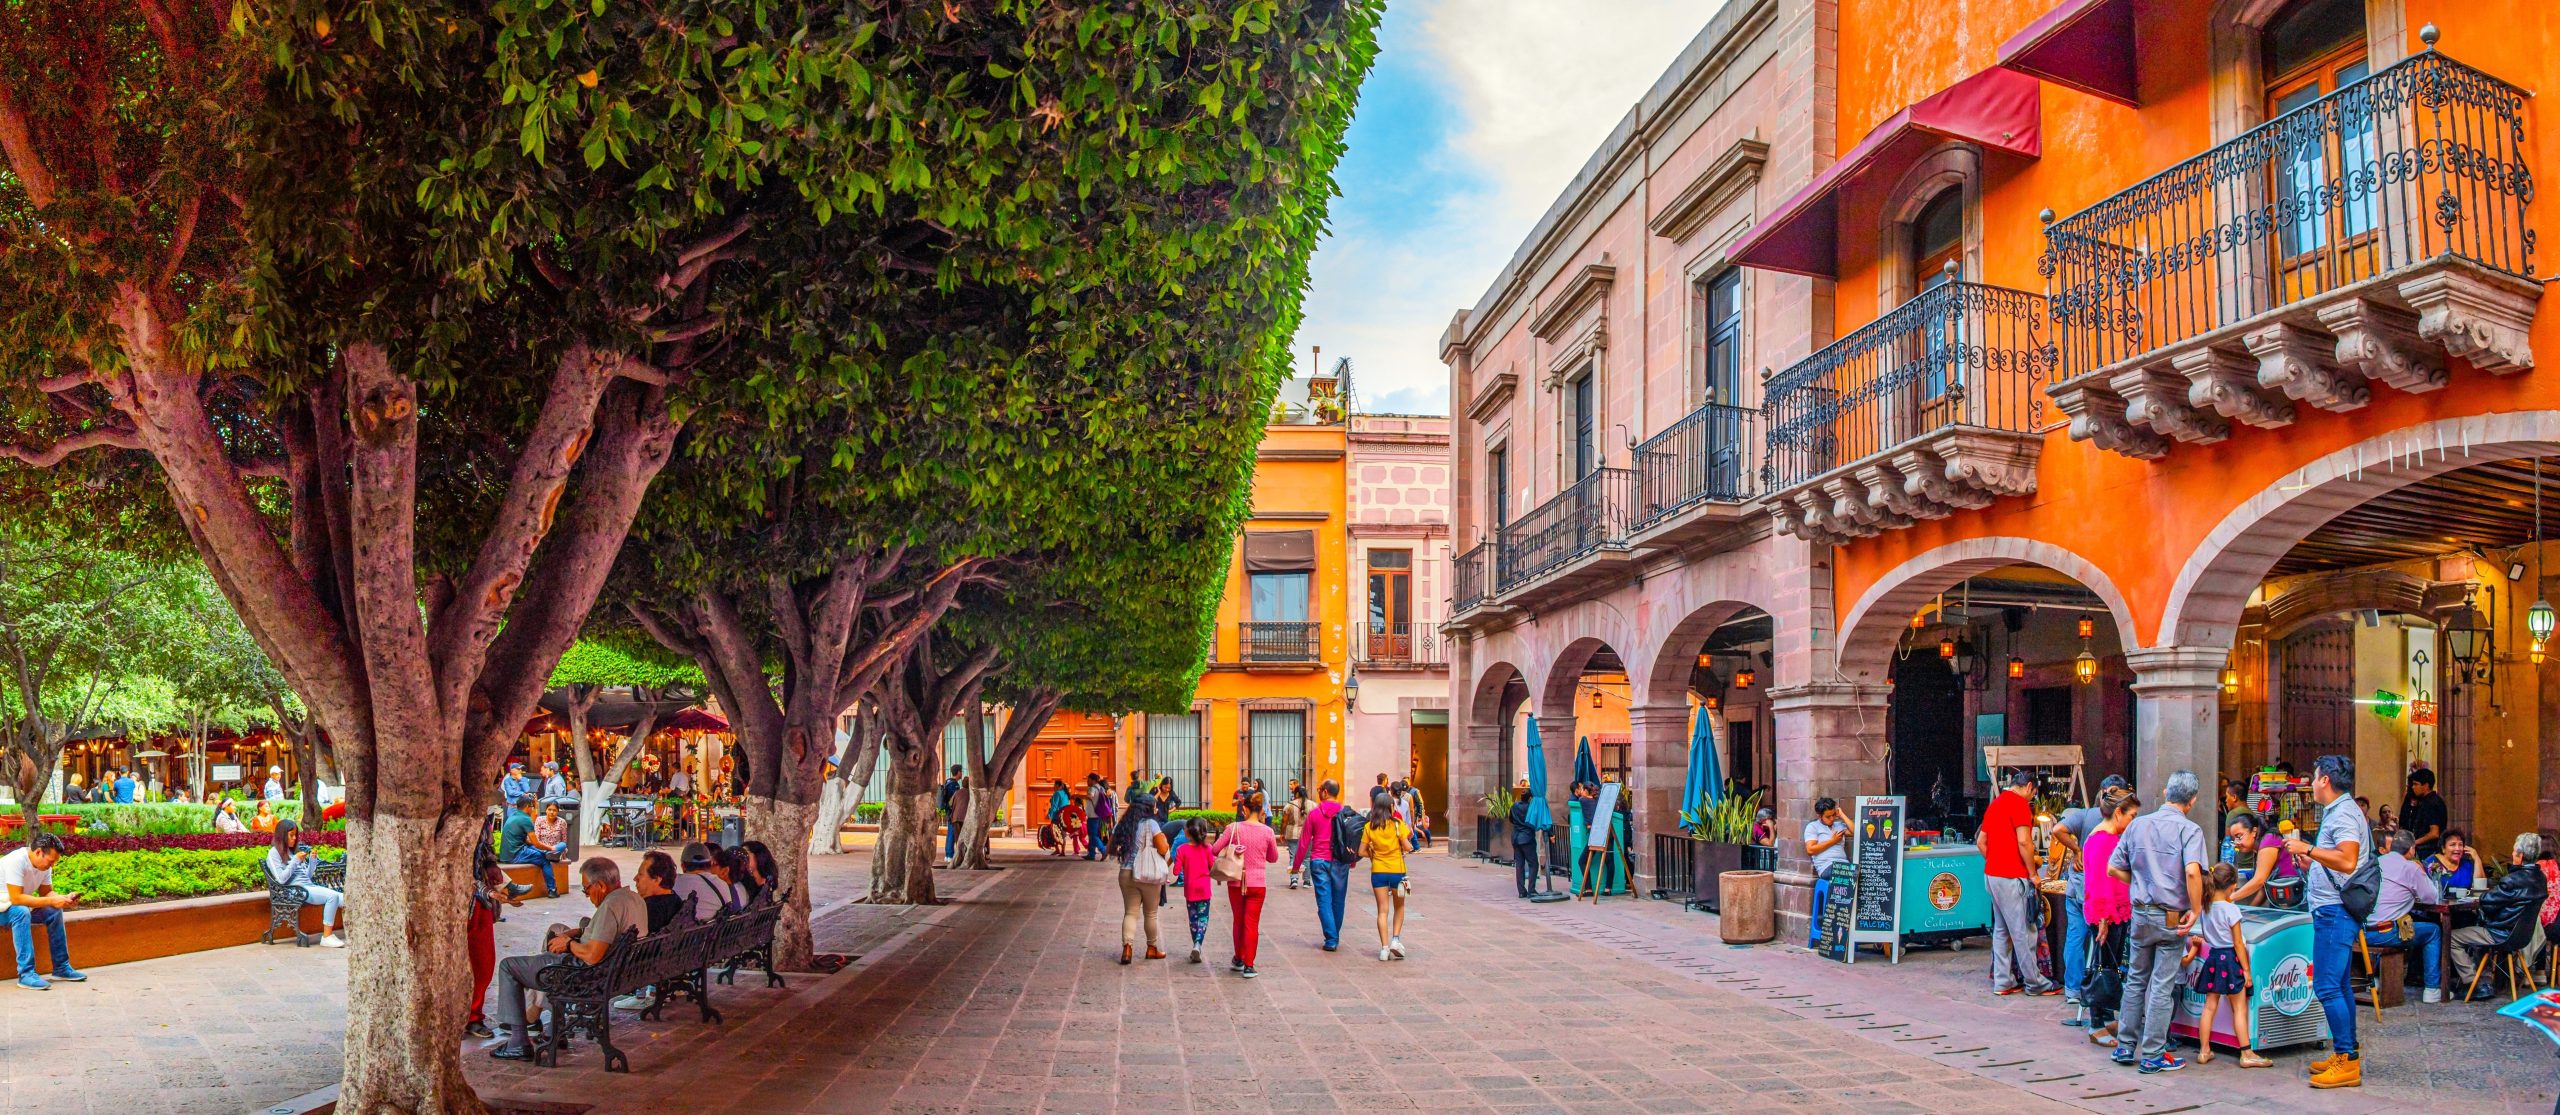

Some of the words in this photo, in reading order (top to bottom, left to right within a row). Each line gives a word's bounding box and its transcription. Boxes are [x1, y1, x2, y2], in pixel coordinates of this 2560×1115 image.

[1866, 797, 1894, 806] Helados
[1868, 808, 1892, 818] Calgary
[1923, 857, 1966, 869] Helados
[1924, 916, 1964, 929] Calgary
[2269, 963, 2302, 990] santo
[2273, 984, 2308, 1003] pecado
